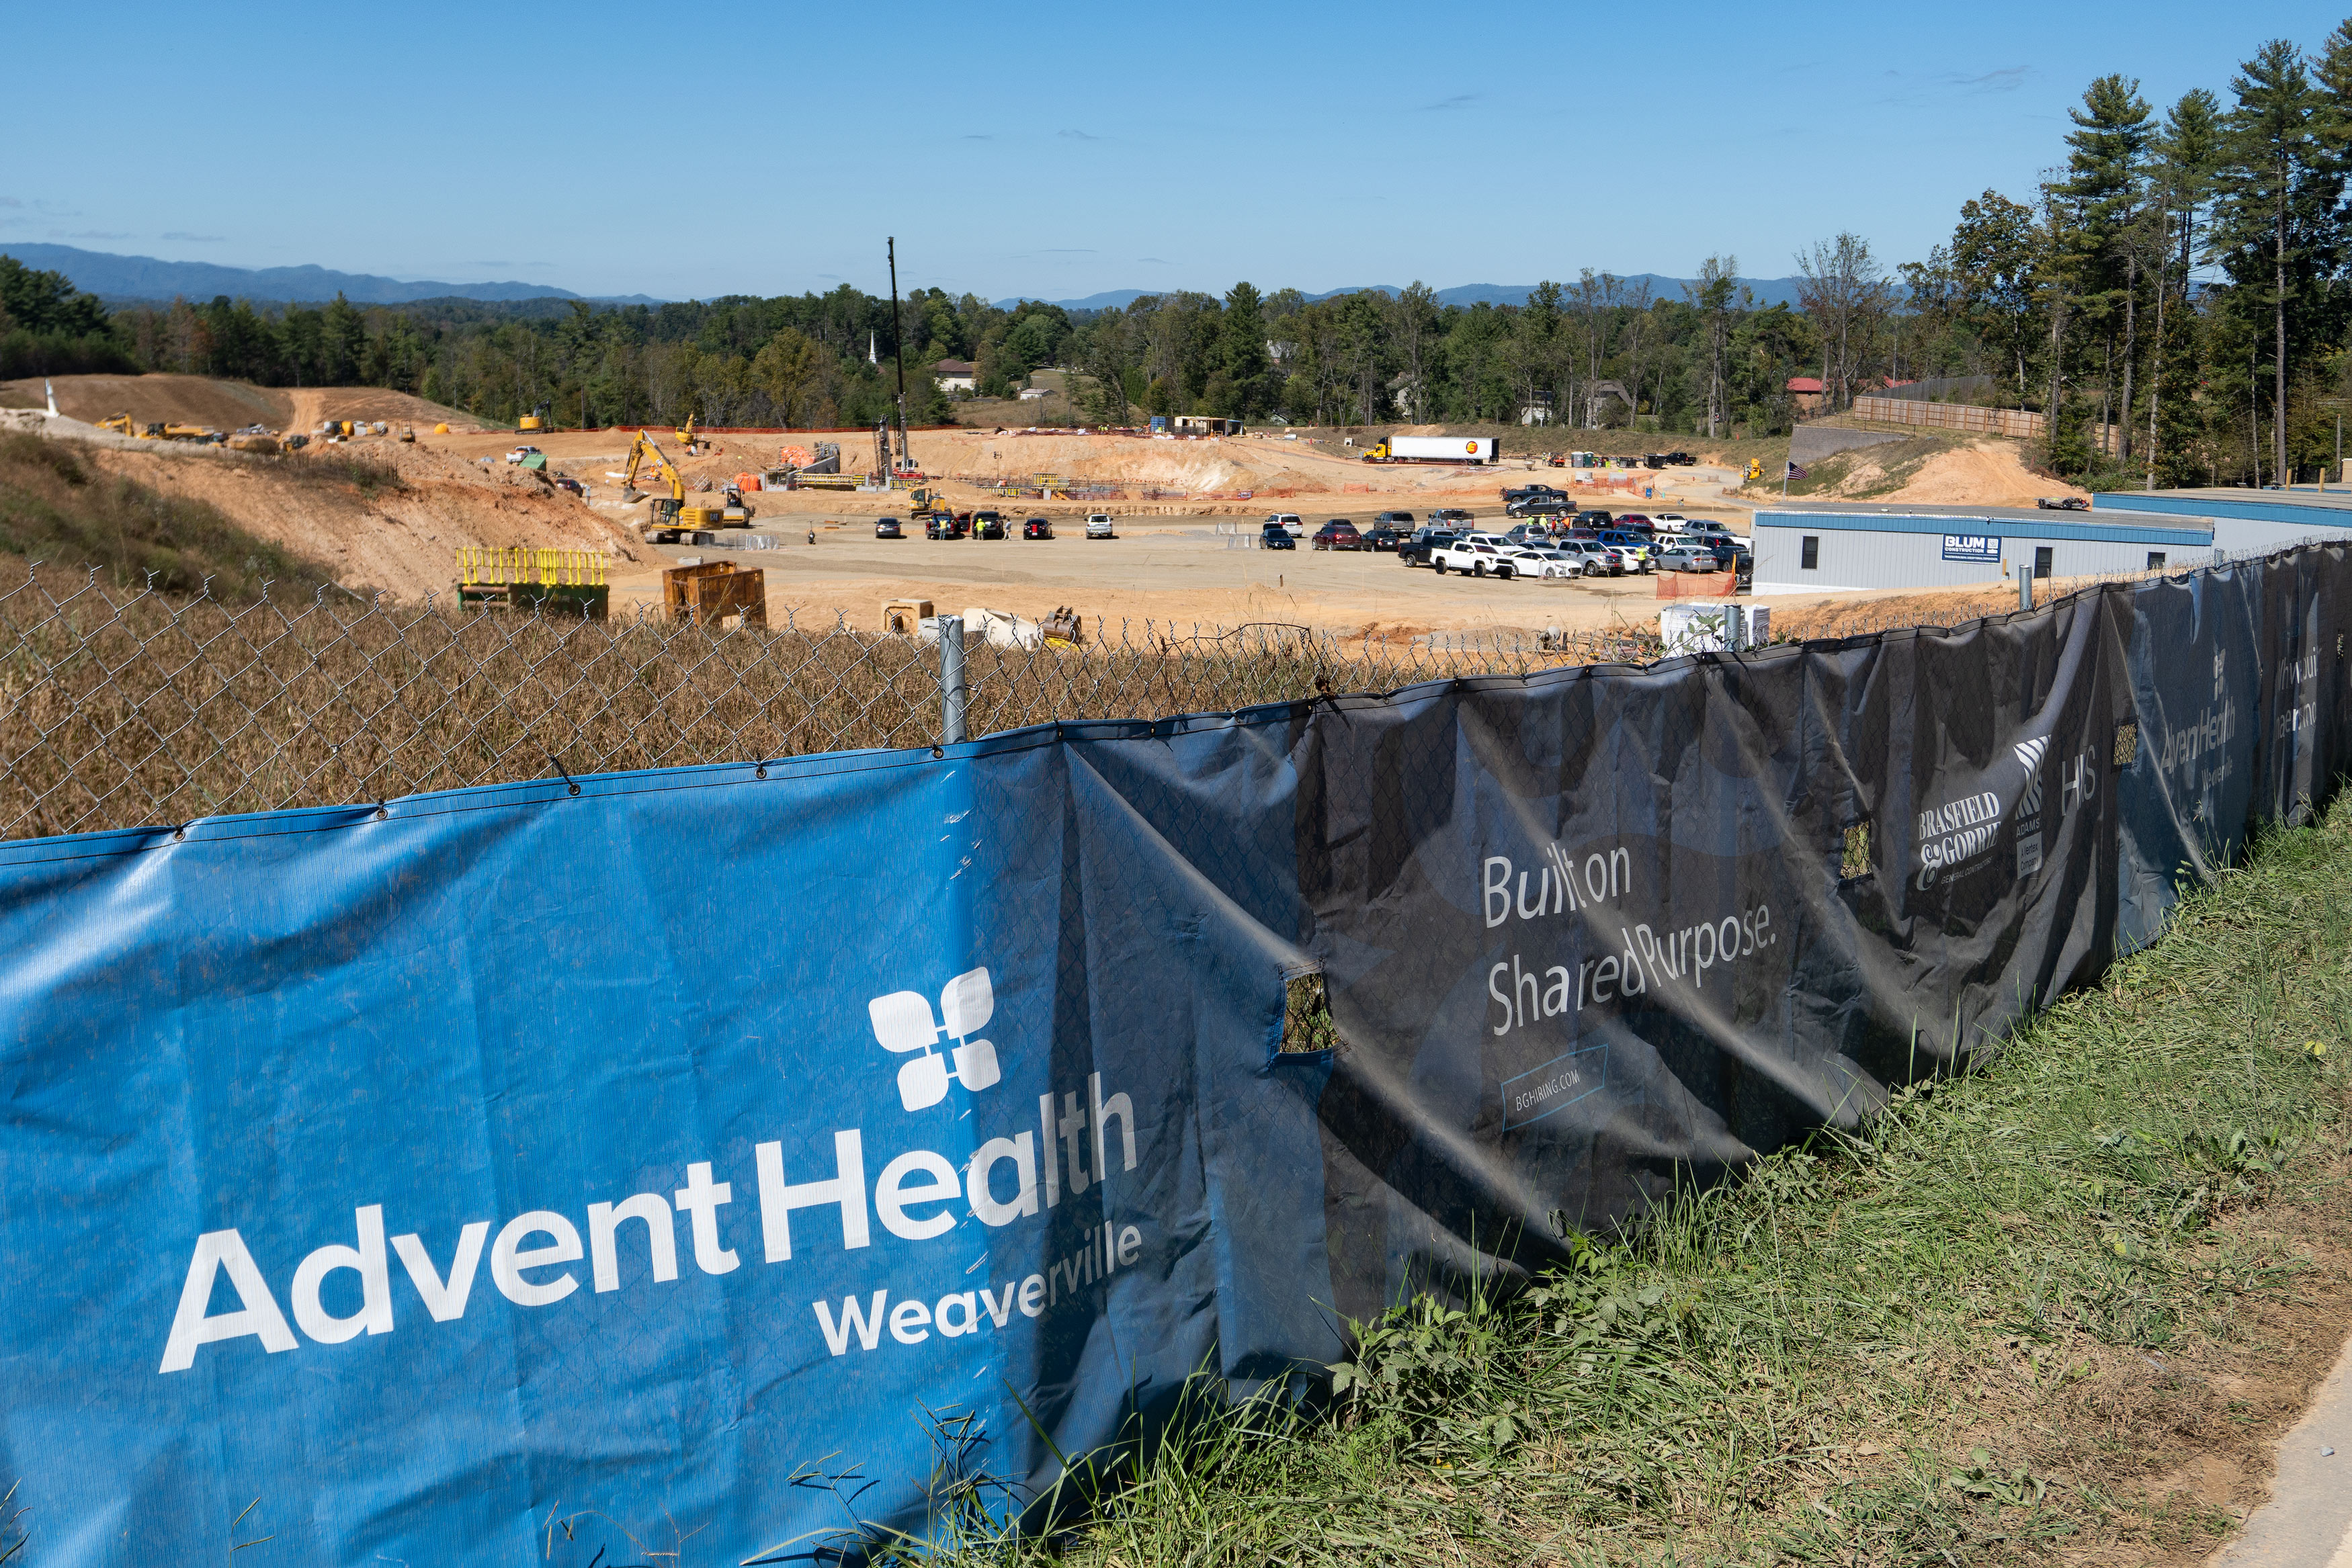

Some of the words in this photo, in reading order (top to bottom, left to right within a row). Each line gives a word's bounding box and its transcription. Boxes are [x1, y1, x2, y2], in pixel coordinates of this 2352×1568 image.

[1945, 536, 1986, 548] BLUM
[1918, 791, 2000, 841] BRASFIELD
[2016, 817, 2040, 838] ADAMS
[1484, 842, 1587, 928] Built
[1585, 846, 1631, 903] on
[1515, 1069, 1580, 1112] BGHIRING.COM
[159, 1072, 1138, 1374] AdventHealth
[812, 1220, 1142, 1357] Weaverville
